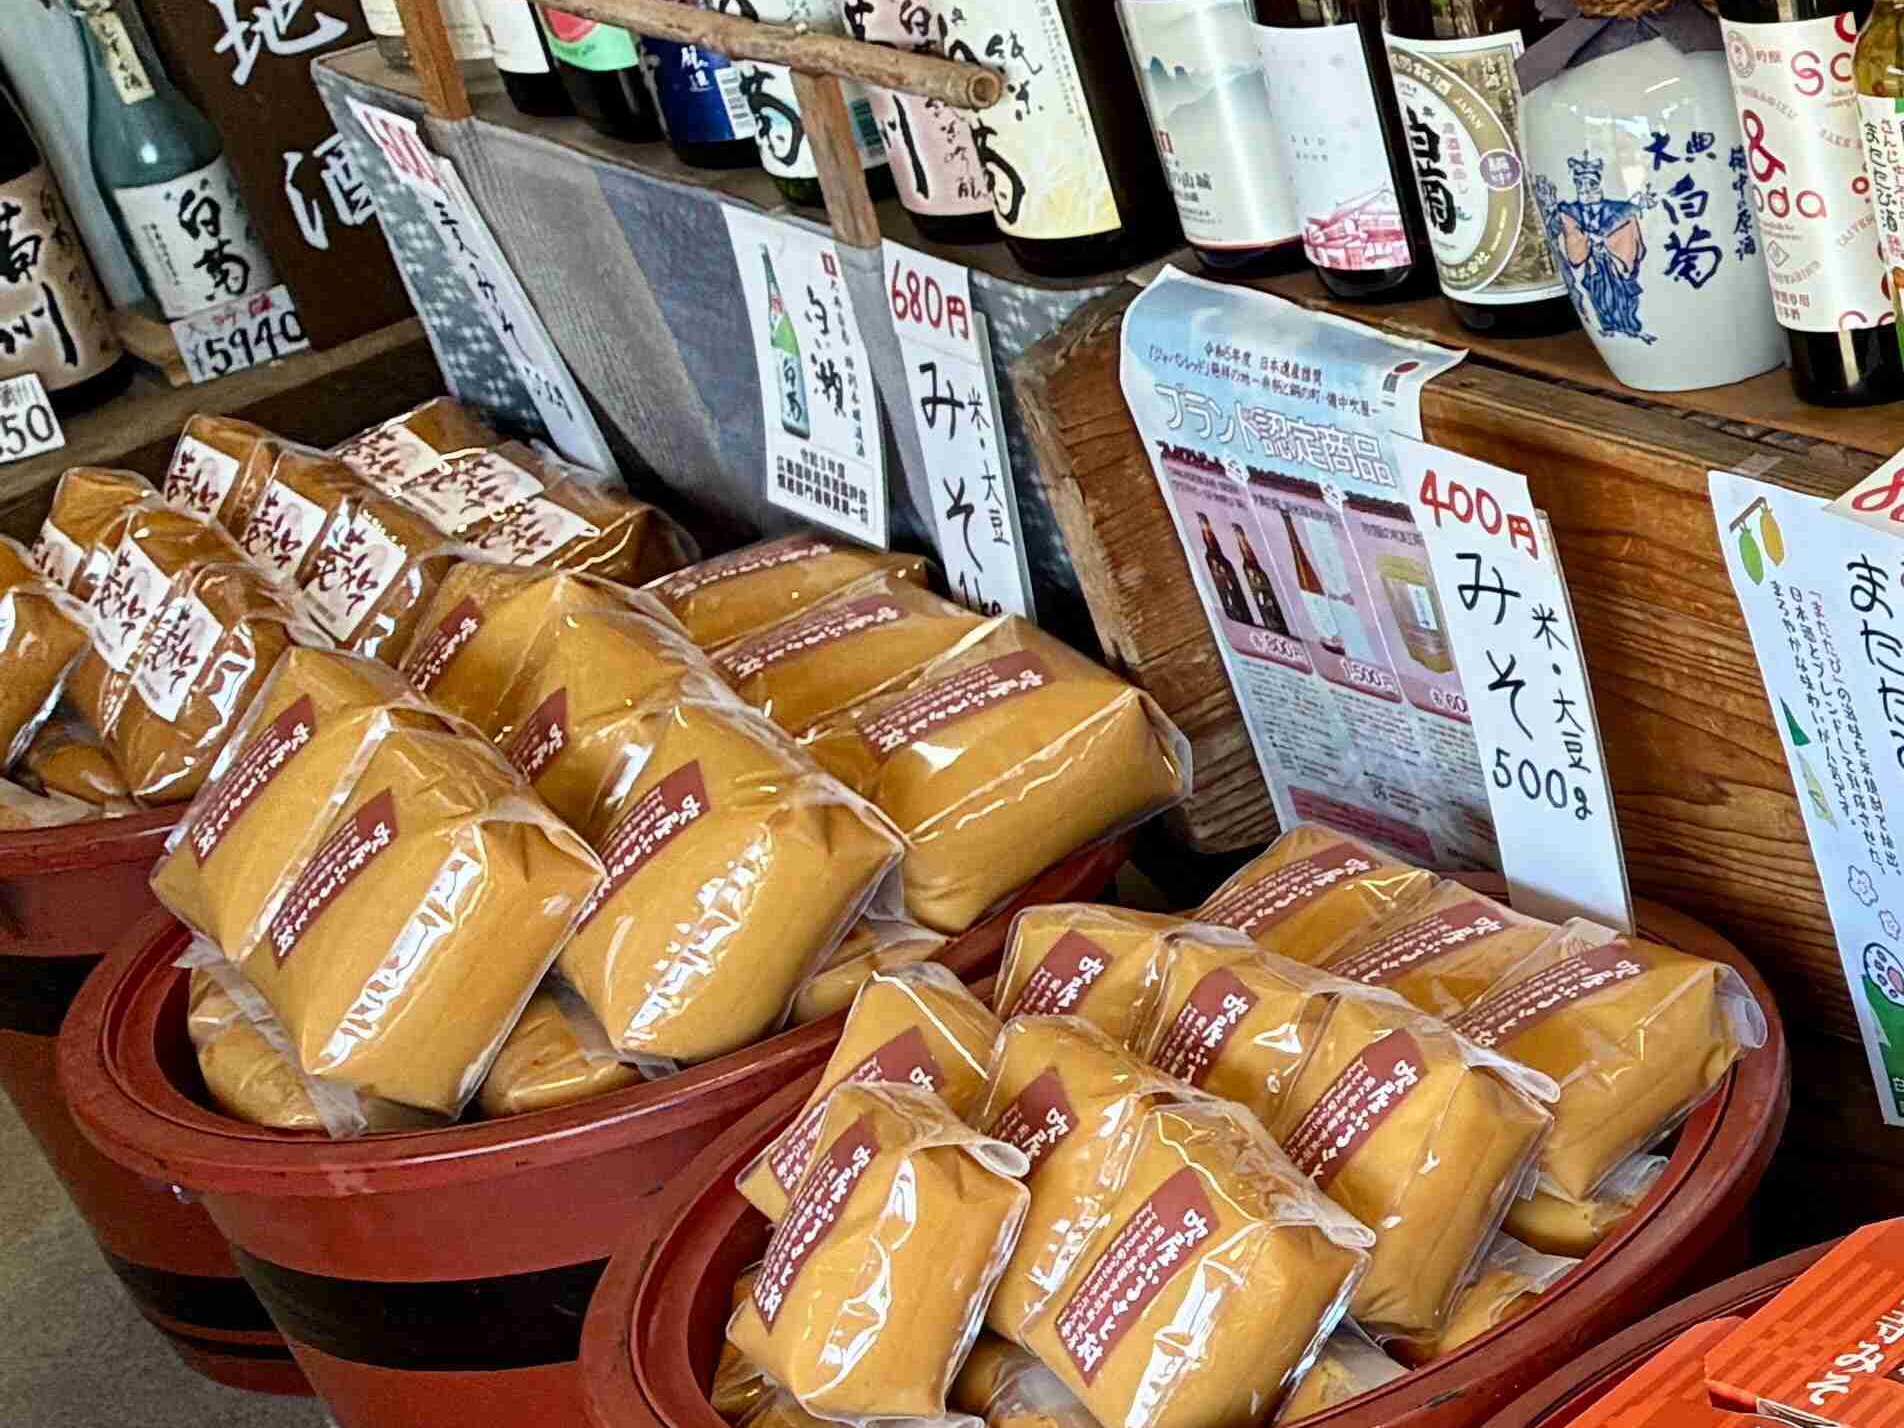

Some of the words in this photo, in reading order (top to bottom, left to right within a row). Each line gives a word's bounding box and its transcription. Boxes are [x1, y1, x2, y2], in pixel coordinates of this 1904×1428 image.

[1659, 172, 1723, 288] 白菊
[889, 259, 970, 341] 680円
[917, 362, 983, 573] みそ
[1154, 383, 1397, 490] ブランド認定商品
[1419, 470, 1539, 561] 400円
[1455, 552, 1534, 741] みそ
[1491, 749, 1594, 820] 500g
